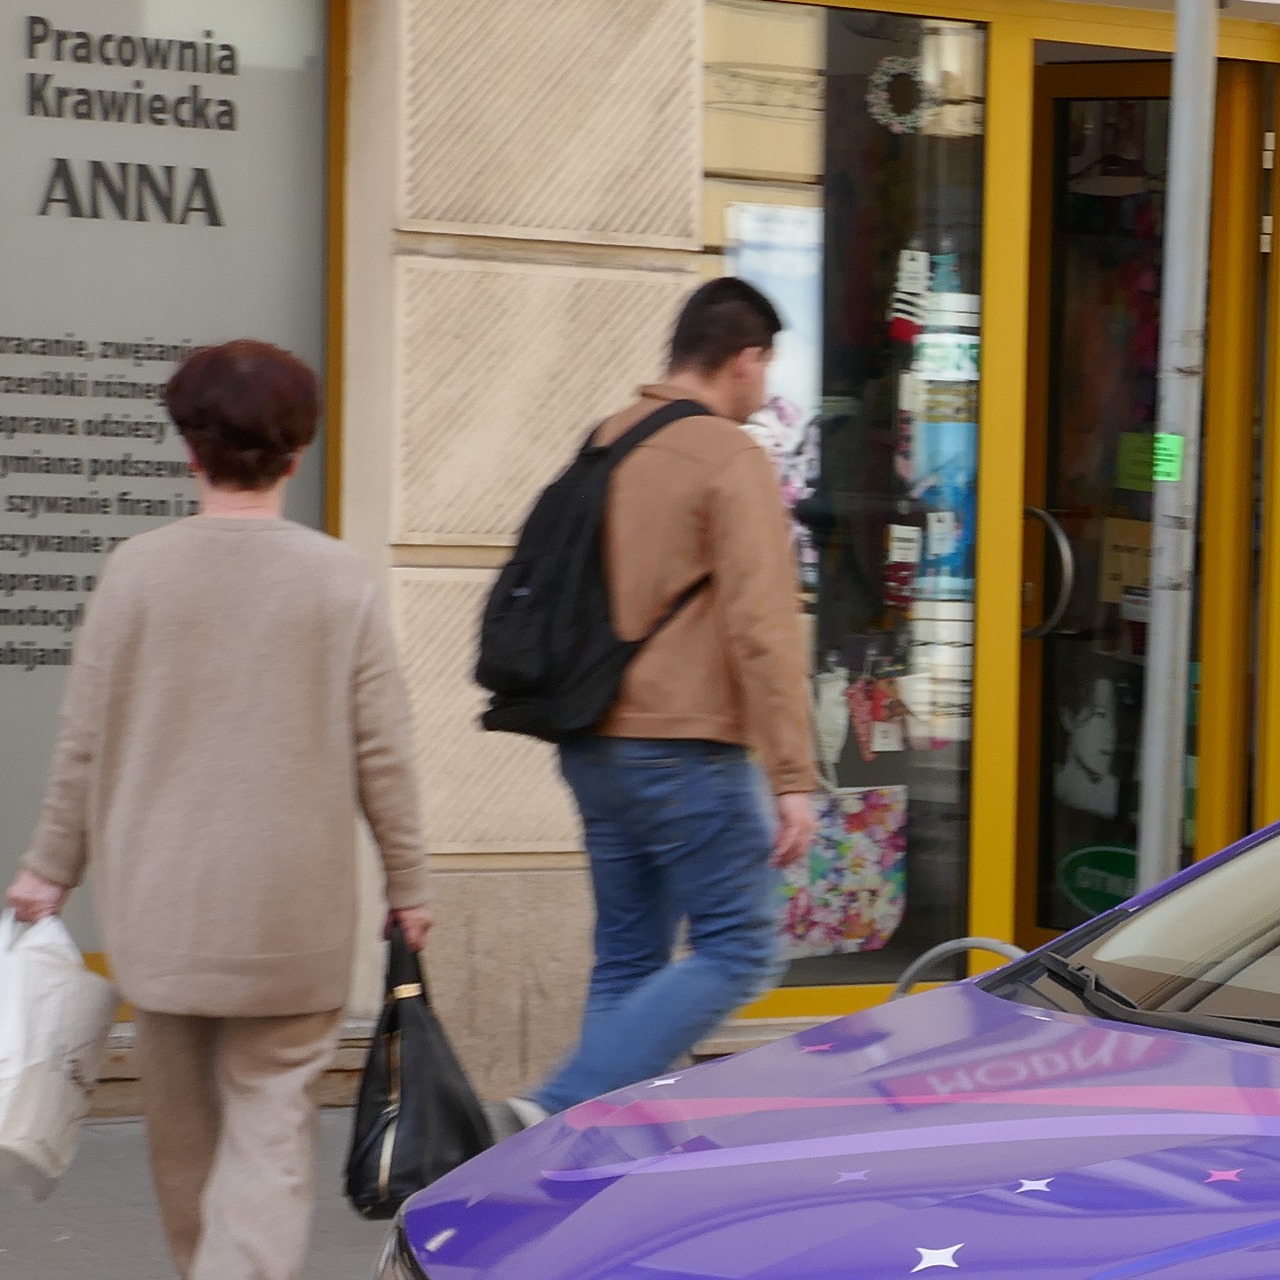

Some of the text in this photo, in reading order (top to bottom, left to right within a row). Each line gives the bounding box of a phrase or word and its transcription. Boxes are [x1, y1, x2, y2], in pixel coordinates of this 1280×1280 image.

[25, 14, 241, 77] Pracownia
[25, 71, 240, 132] Krawiecka
[36, 156, 227, 228] ANNA
